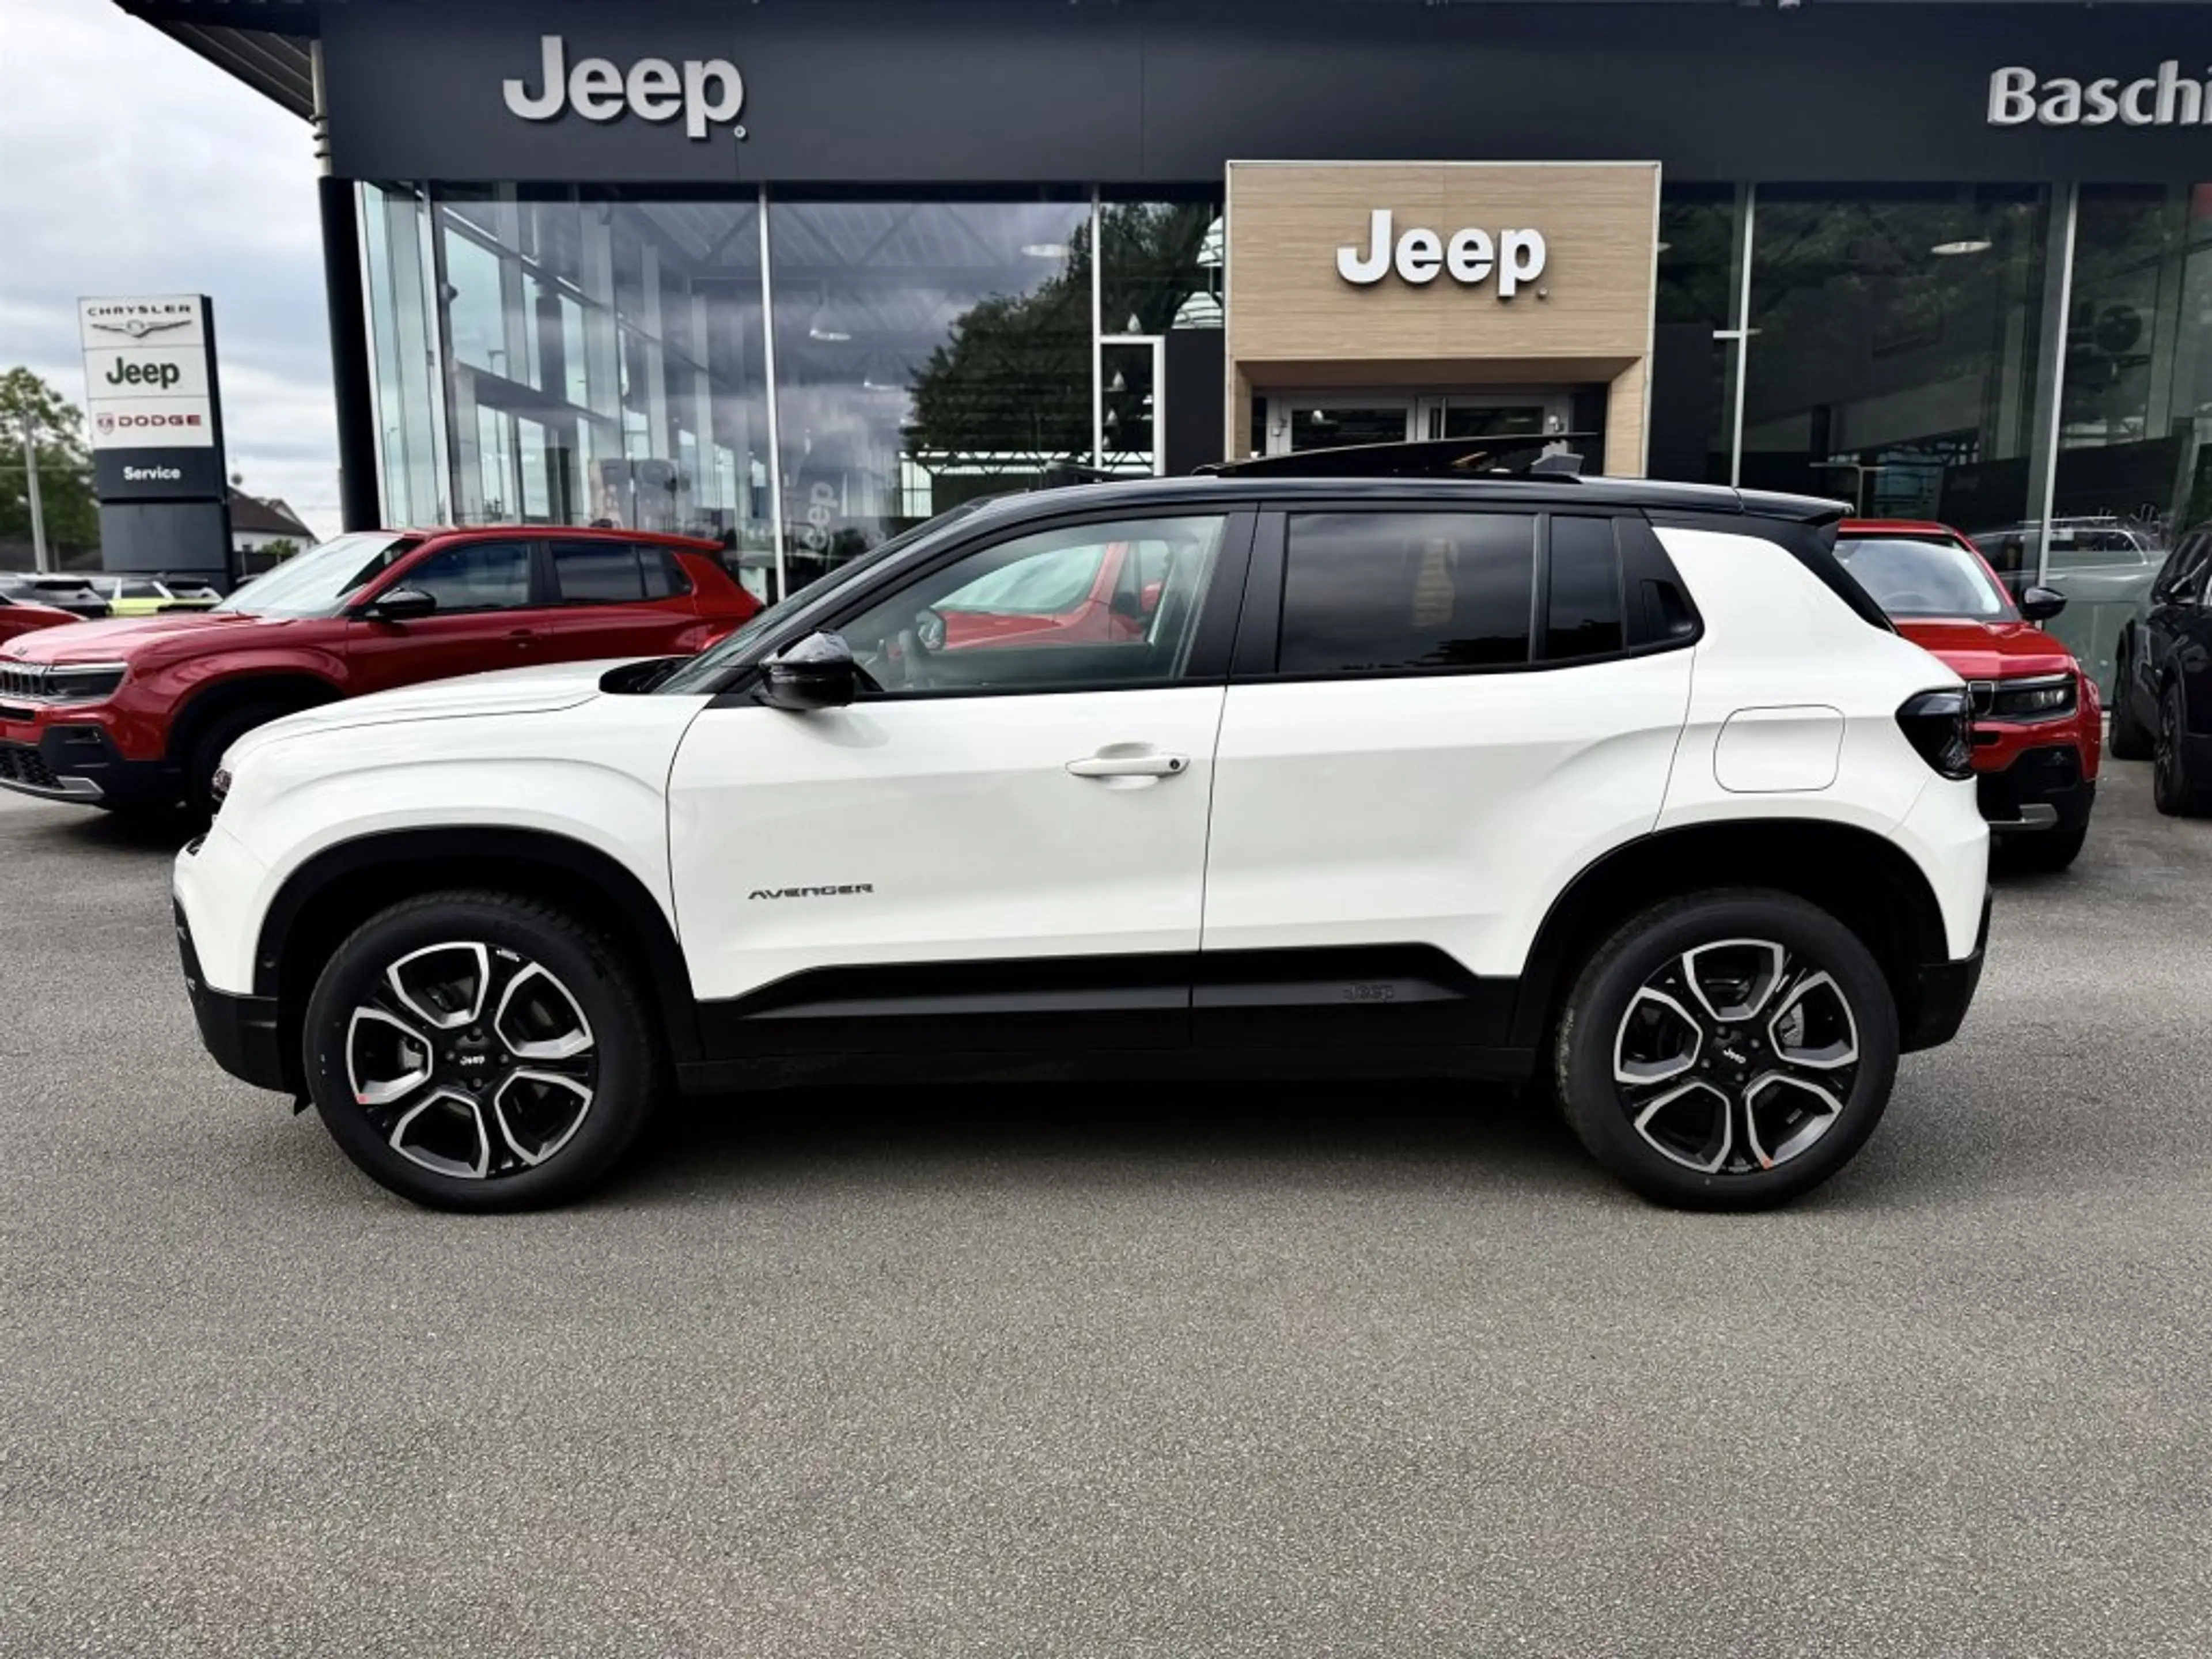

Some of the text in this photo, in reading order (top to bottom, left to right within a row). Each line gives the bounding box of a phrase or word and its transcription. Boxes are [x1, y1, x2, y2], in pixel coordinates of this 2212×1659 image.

[503, 35, 743, 138] Jeep
[1337, 209, 1546, 296] Jeep
[88, 304, 191, 317] CHRYSLER
[106, 357, 180, 389] Jeep
[118, 415, 201, 427] DODGE
[123, 465, 181, 481] Service
[748, 884, 873, 900] AVENGER
